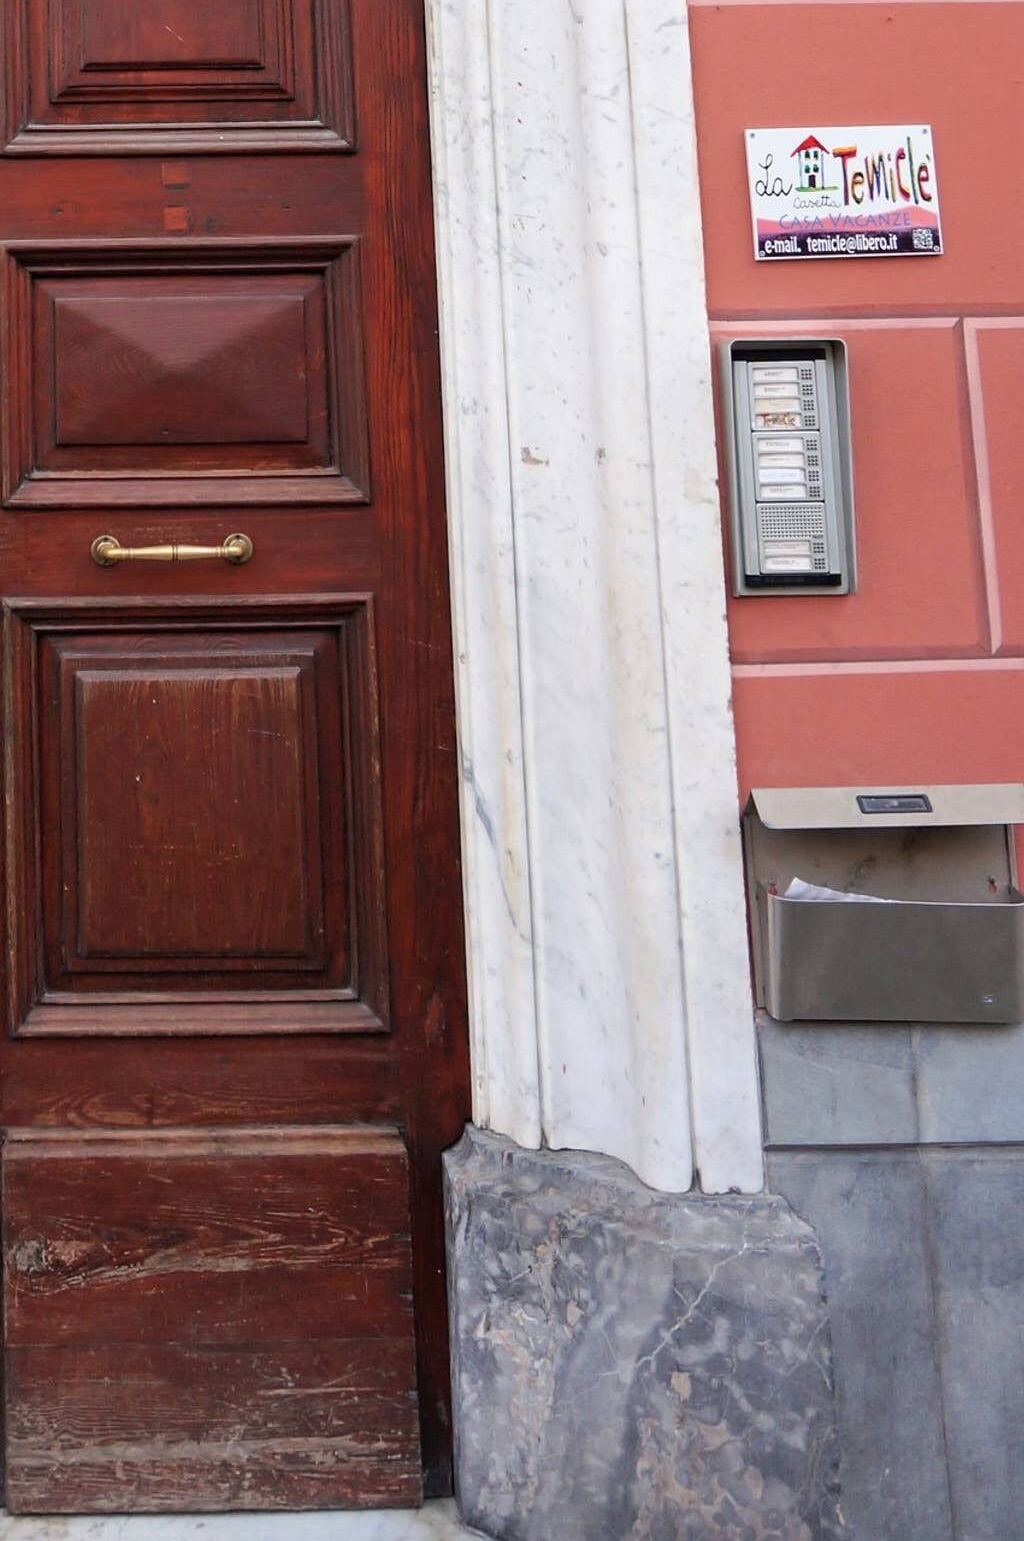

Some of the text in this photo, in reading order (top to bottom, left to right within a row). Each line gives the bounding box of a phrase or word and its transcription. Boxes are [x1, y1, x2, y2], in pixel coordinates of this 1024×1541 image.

[755, 153, 793, 197] La
[792, 195, 842, 209] Casetta
[779, 211, 912, 229] CASA VACANZE
[806, 233, 898, 253] temicle@libero.it
